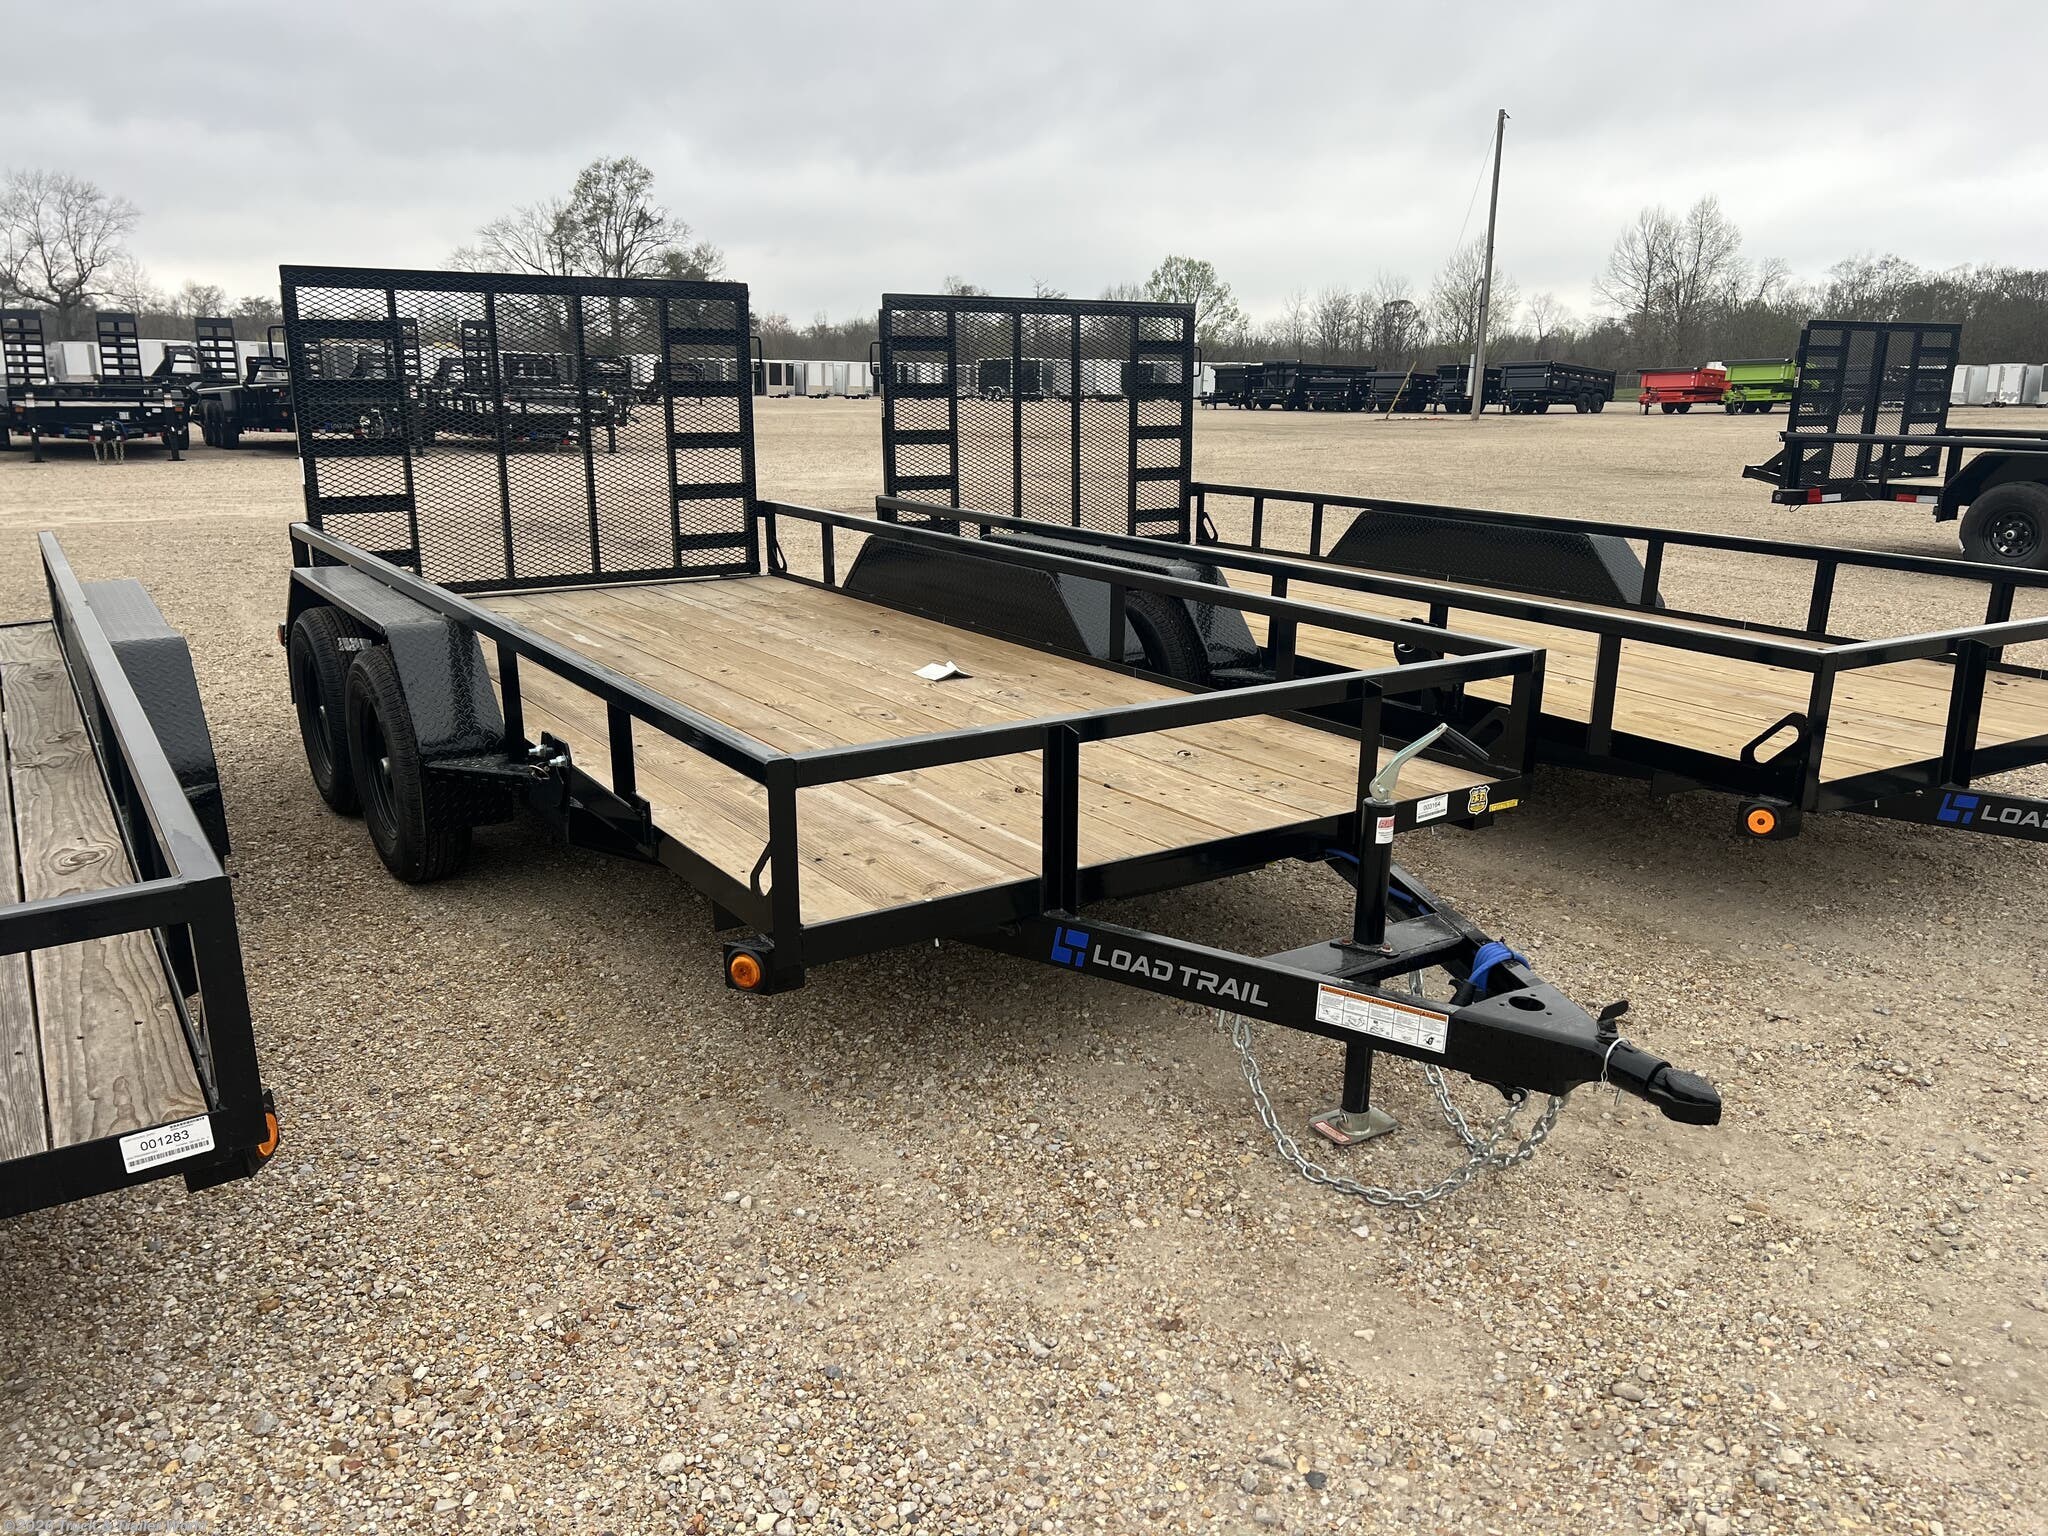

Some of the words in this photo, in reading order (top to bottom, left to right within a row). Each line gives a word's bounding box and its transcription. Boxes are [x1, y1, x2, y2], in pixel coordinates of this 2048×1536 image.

[1092, 944, 1174, 982] LOAD
[1179, 965, 1269, 1008] TRAIL
[140, 1130, 190, 1152] 001283
